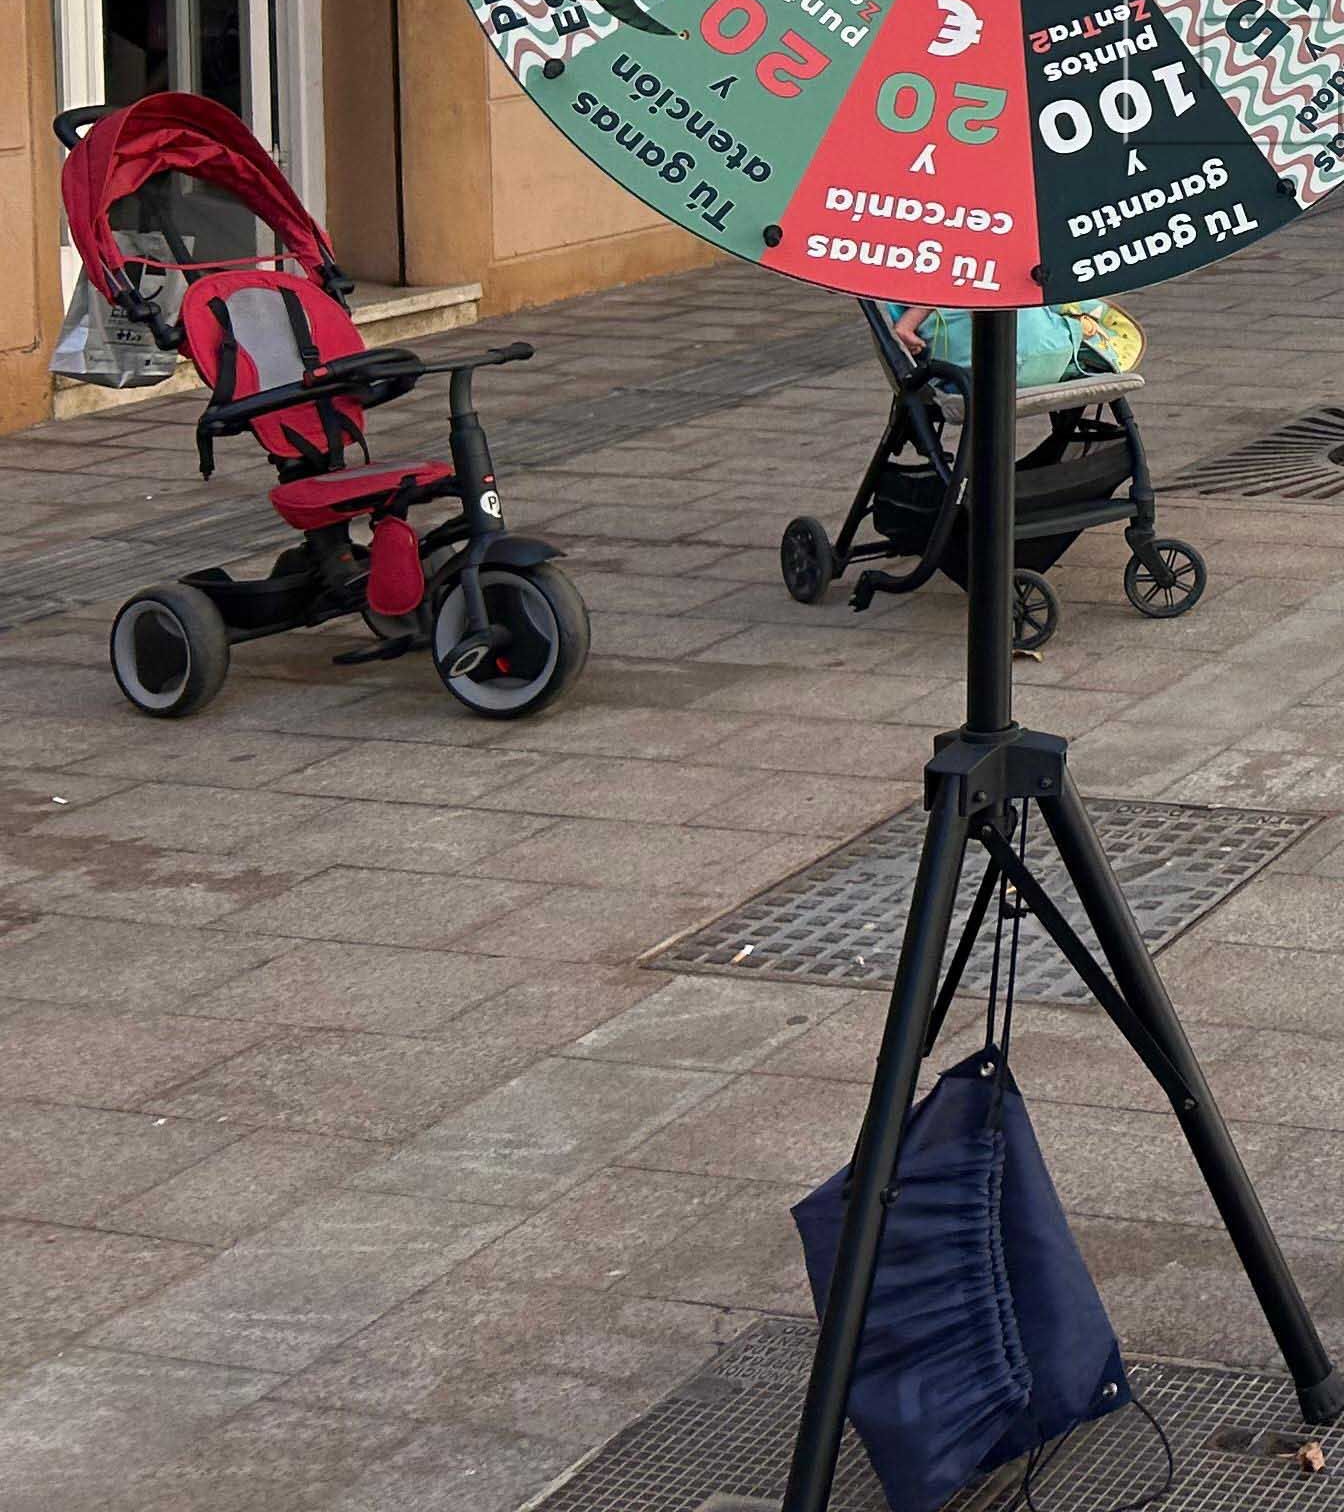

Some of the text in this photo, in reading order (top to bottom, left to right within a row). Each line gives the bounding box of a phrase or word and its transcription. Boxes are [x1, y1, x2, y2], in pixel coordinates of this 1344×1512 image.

[1043, 24, 1159, 83] puntos
[1305, 38, 1328, 61] y
[709, 75, 738, 99] y
[875, 71, 1008, 146] 20
[1037, 60, 1198, 156] 100
[610, 53, 773, 184] atención
[570, 89, 737, 233] Tú ganas
[909, 143, 937, 176] y
[1124, 149, 1148, 178] y
[824, 187, 1014, 234] cercanía
[1066, 158, 1230, 241] garantía
[806, 233, 1000, 292] Tú ganas
[1071, 200, 1259, 284] Tú ganas
